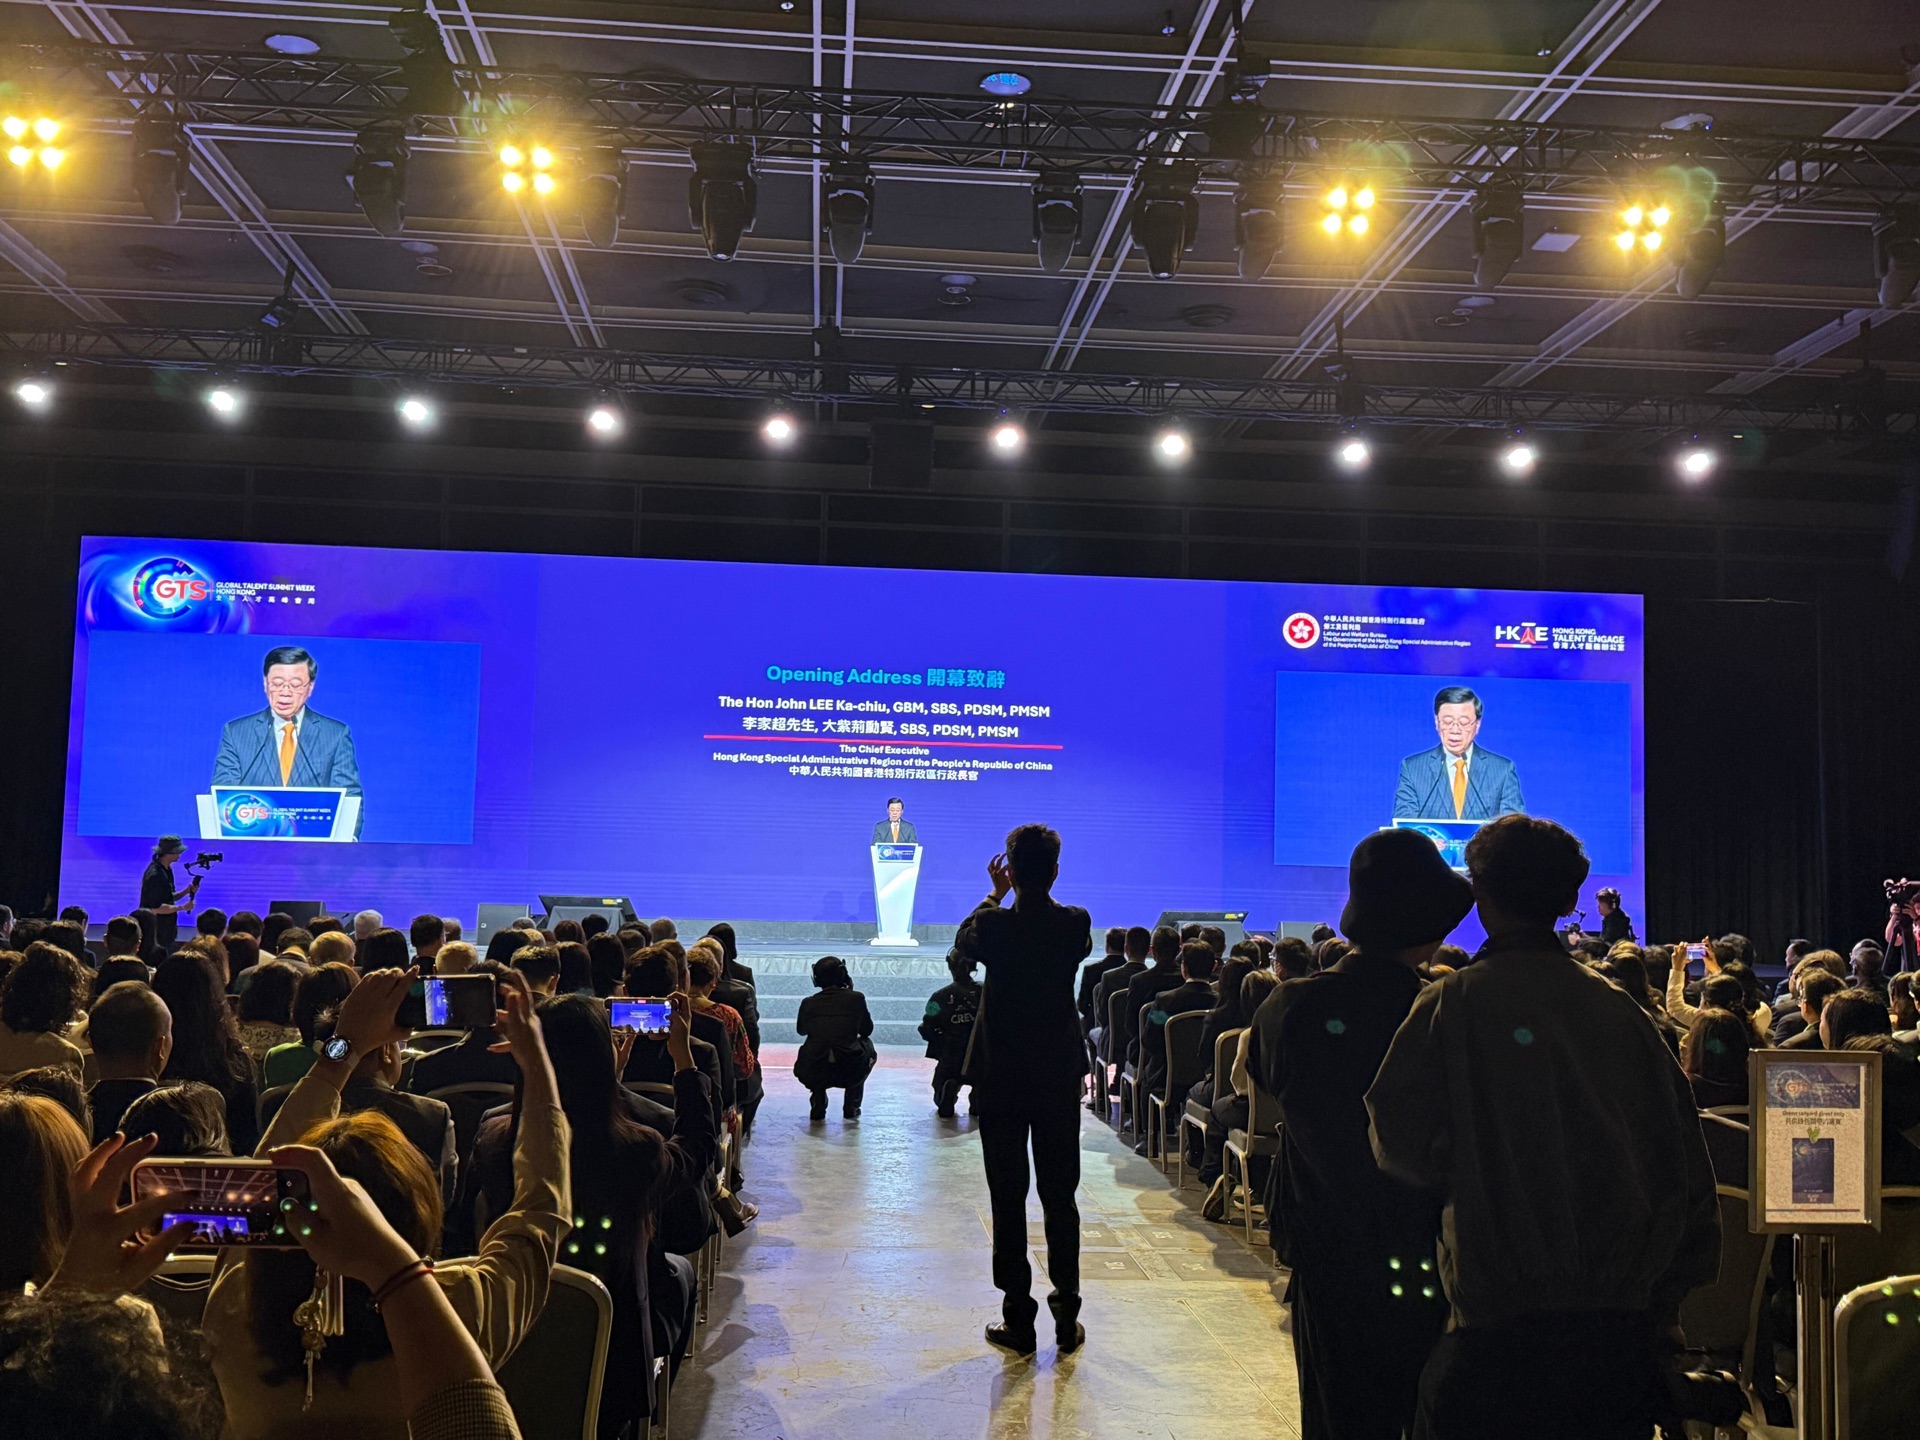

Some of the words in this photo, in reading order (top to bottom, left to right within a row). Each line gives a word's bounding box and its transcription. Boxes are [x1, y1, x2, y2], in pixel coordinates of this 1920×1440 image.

[156, 580, 206, 601] GTS
[216, 581, 242, 590] GLOBAL
[242, 582, 268, 591] TALENT
[268, 583, 294, 592] SUMMIT
[295, 584, 315, 593] WEEK
[1552, 627, 1574, 635] HONG
[1575, 628, 1596, 636] KONG
[1552, 634, 1586, 643] TALENT
[1588, 635, 1625, 644] ENGAGE
[1454, 640, 1471, 648] Region
[766, 664, 844, 686] Opening
[847, 668, 922, 685] Address
[927, 668, 1005, 689] 開幕致辭
[718, 695, 744, 708] The
[745, 696, 774, 709] Hon
[775, 697, 807, 710] John
[809, 698, 834, 711] LEE
[836, 699, 890, 715] Ka-chiu,
[892, 701, 928, 716] GBM,
[930, 702, 962, 717] SBS,
[963, 703, 1007, 718] PDSM,
[1009, 704, 1050, 718] PMSM
[899, 722, 930, 738] SBS,
[932, 724, 975, 739] PDSM,
[977, 725, 1019, 738] PMSM
[839, 744, 857, 753] The
[858, 745, 884, 754] Chief
[884, 746, 930, 756] Executive
[713, 752, 739, 764] Hong
[739, 753, 764, 764] Kong
[764, 754, 800, 765] Special
[801, 755, 869, 766] Administrative
[870, 757, 904, 768] Region
[904, 757, 914, 766] of
[914, 758, 930, 767] the
[931, 758, 971, 769] People's
[972, 759, 1013, 770] Republic
[1014, 761, 1025, 770] of
[1025, 761, 1053, 771] China
[789, 765, 979, 782] 中華人民共和國香港特別行政區行政長官
[238, 807, 268, 820] GTS
